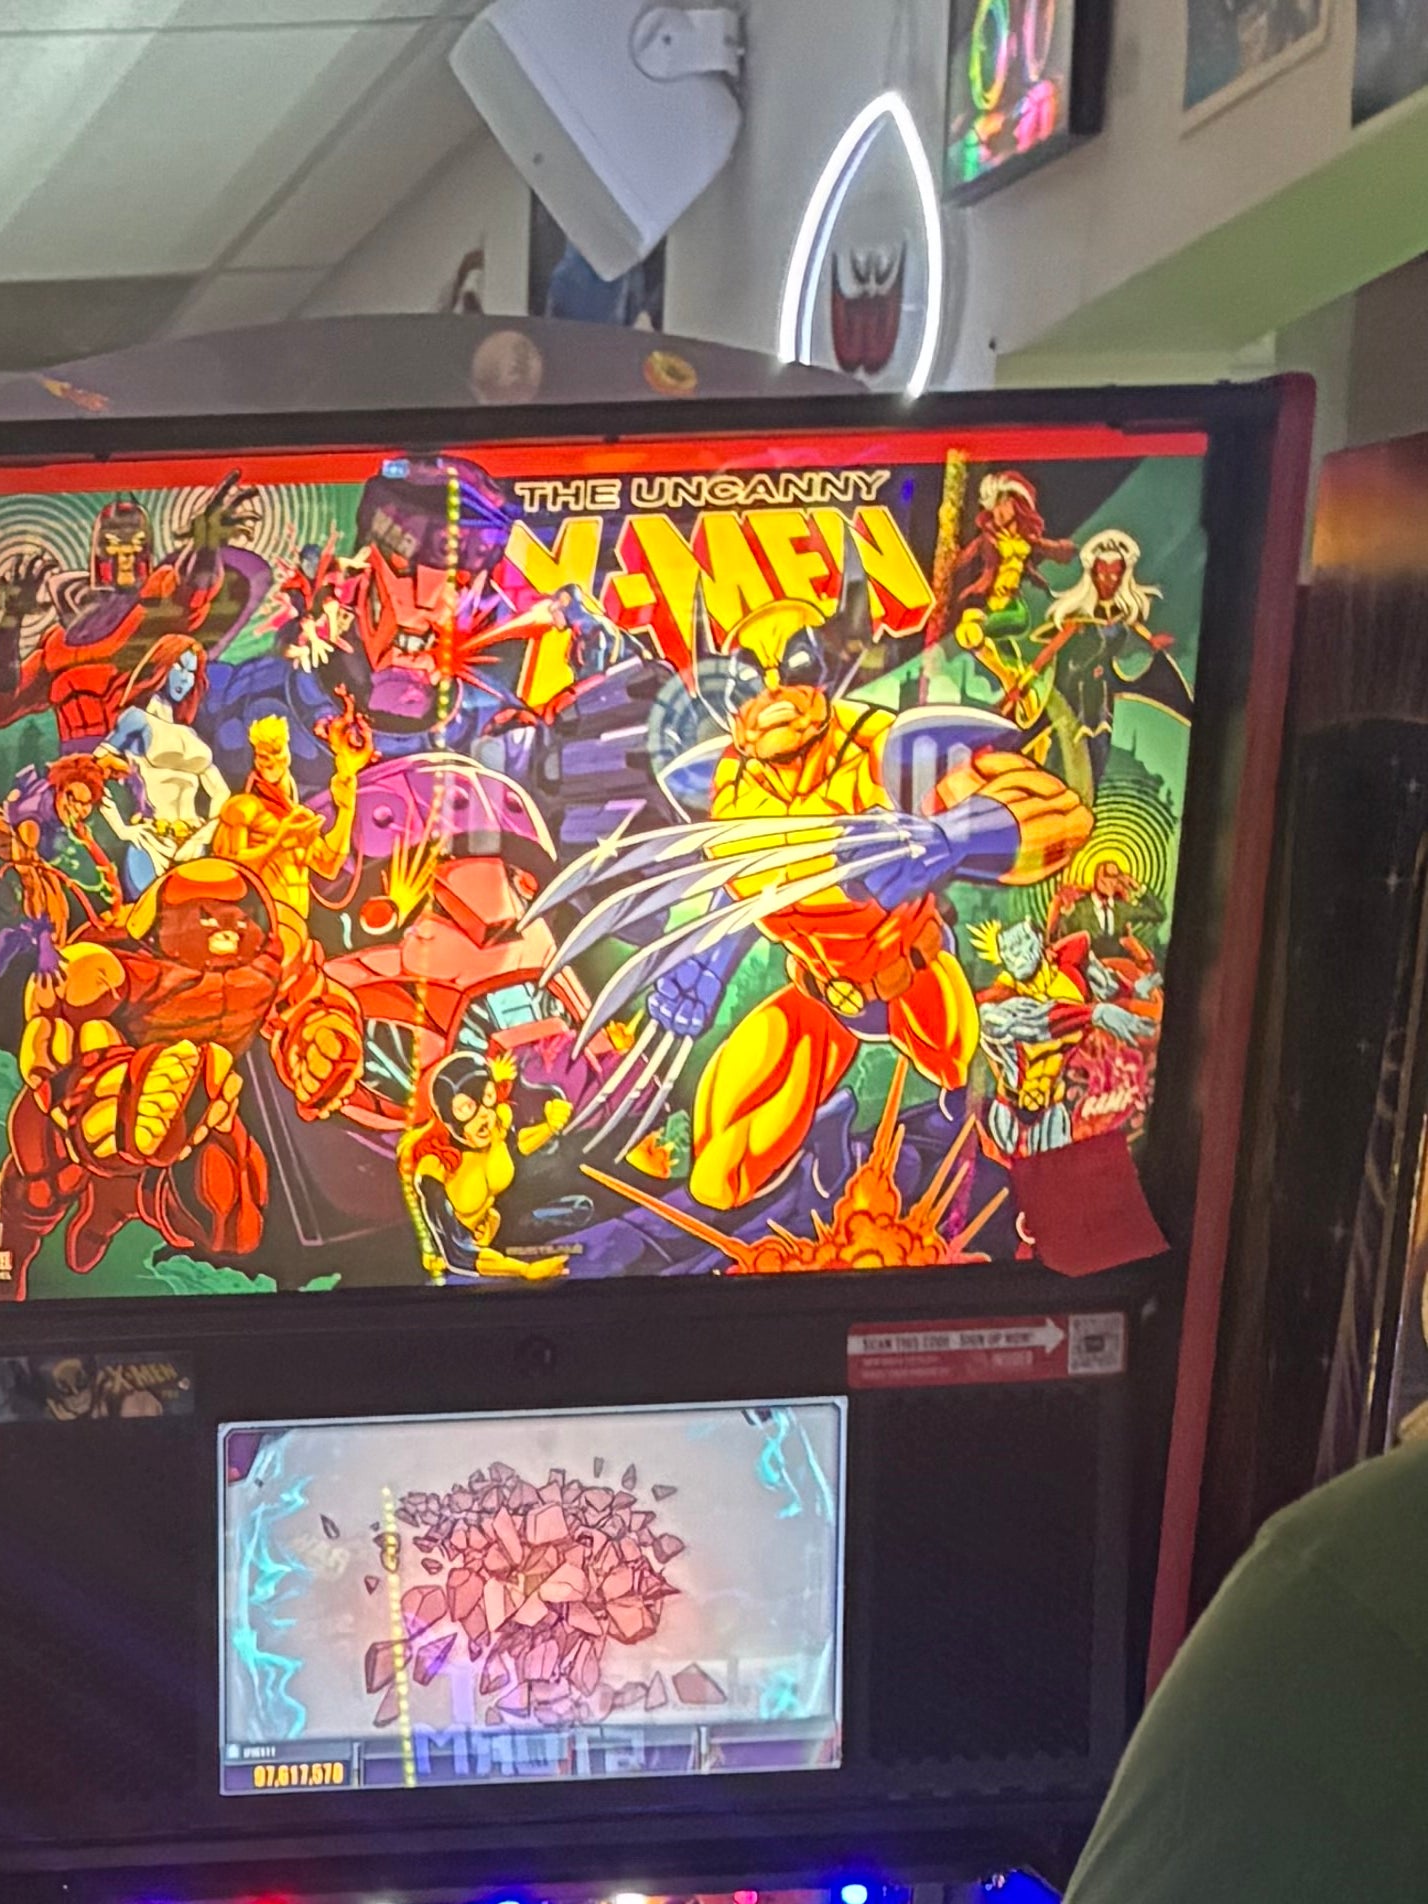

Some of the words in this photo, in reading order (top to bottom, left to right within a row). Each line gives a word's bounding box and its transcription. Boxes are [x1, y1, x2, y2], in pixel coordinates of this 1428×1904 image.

[515, 479, 620, 512] THE
[631, 471, 891, 508] UNCANNY
[502, 504, 936, 710] X-MEN
[104, 1362, 179, 1394] X-MEN
